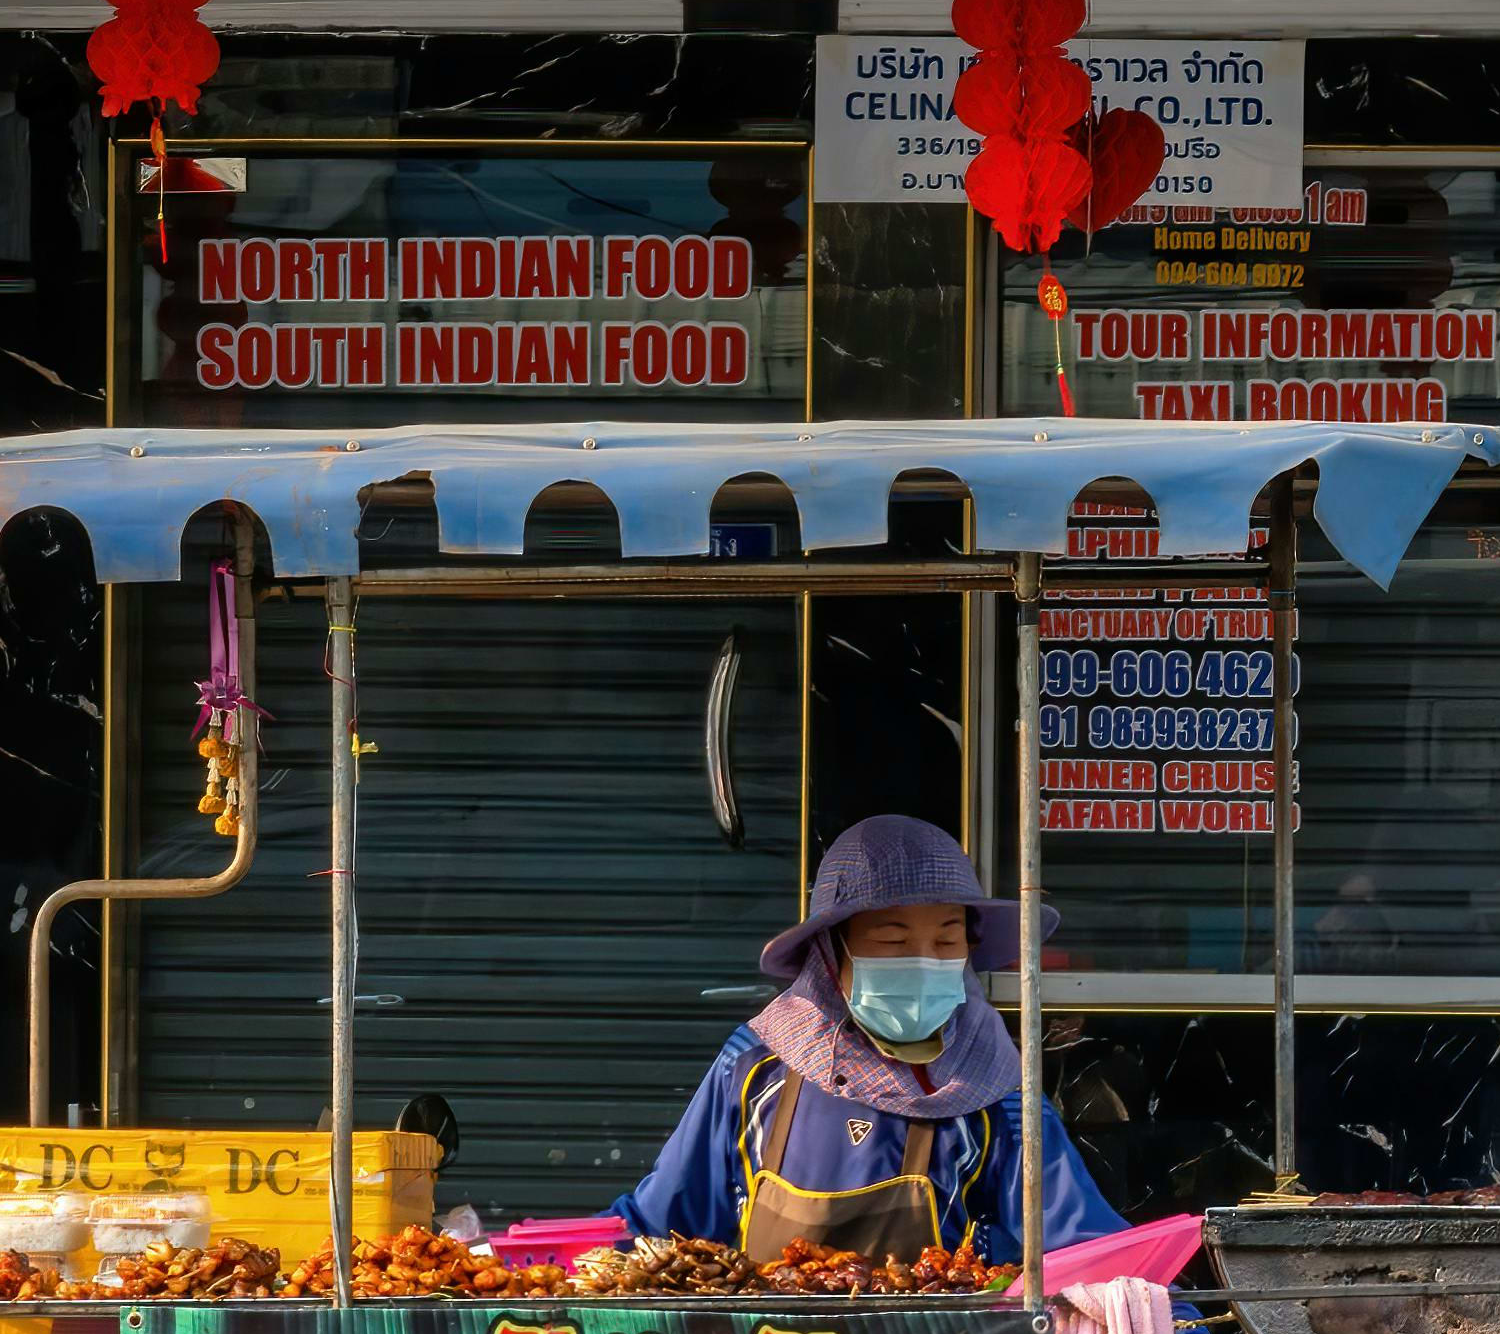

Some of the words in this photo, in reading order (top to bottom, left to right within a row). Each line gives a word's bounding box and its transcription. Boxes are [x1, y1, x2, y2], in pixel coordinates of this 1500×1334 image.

[857, 48, 943, 80] บริษัท
[1182, 51, 1264, 84] จำกัด
[1146, 175, 1213, 194] 0150
[1155, 228, 1216, 250] Home
[1221, 227, 1311, 252] Delivery
[200, 238, 388, 304] NORTH
[399, 235, 593, 302] INDIAN
[603, 235, 752, 300] FOOD
[197, 323, 387, 389] SOUTH
[396, 321, 592, 387] INDIAN
[601, 320, 750, 386] FOOD
[1072, 309, 1192, 361] TOUR
[1200, 308, 1497, 361] INFORMATION
[1133, 382, 1234, 421] TAXI
[1247, 378, 1447, 423] BOOKING
[1040, 609, 1174, 642] ANCTUARY
[1176, 609, 1211, 640] OF
[1040, 649, 1192, 697] 99-606
[1196, 650, 1299, 698] 462
[1089, 705, 1298, 750] 983938237
[1159, 800, 1300, 833] WORL
[39, 1143, 114, 1190] DC
[224, 1147, 300, 1195] DC
